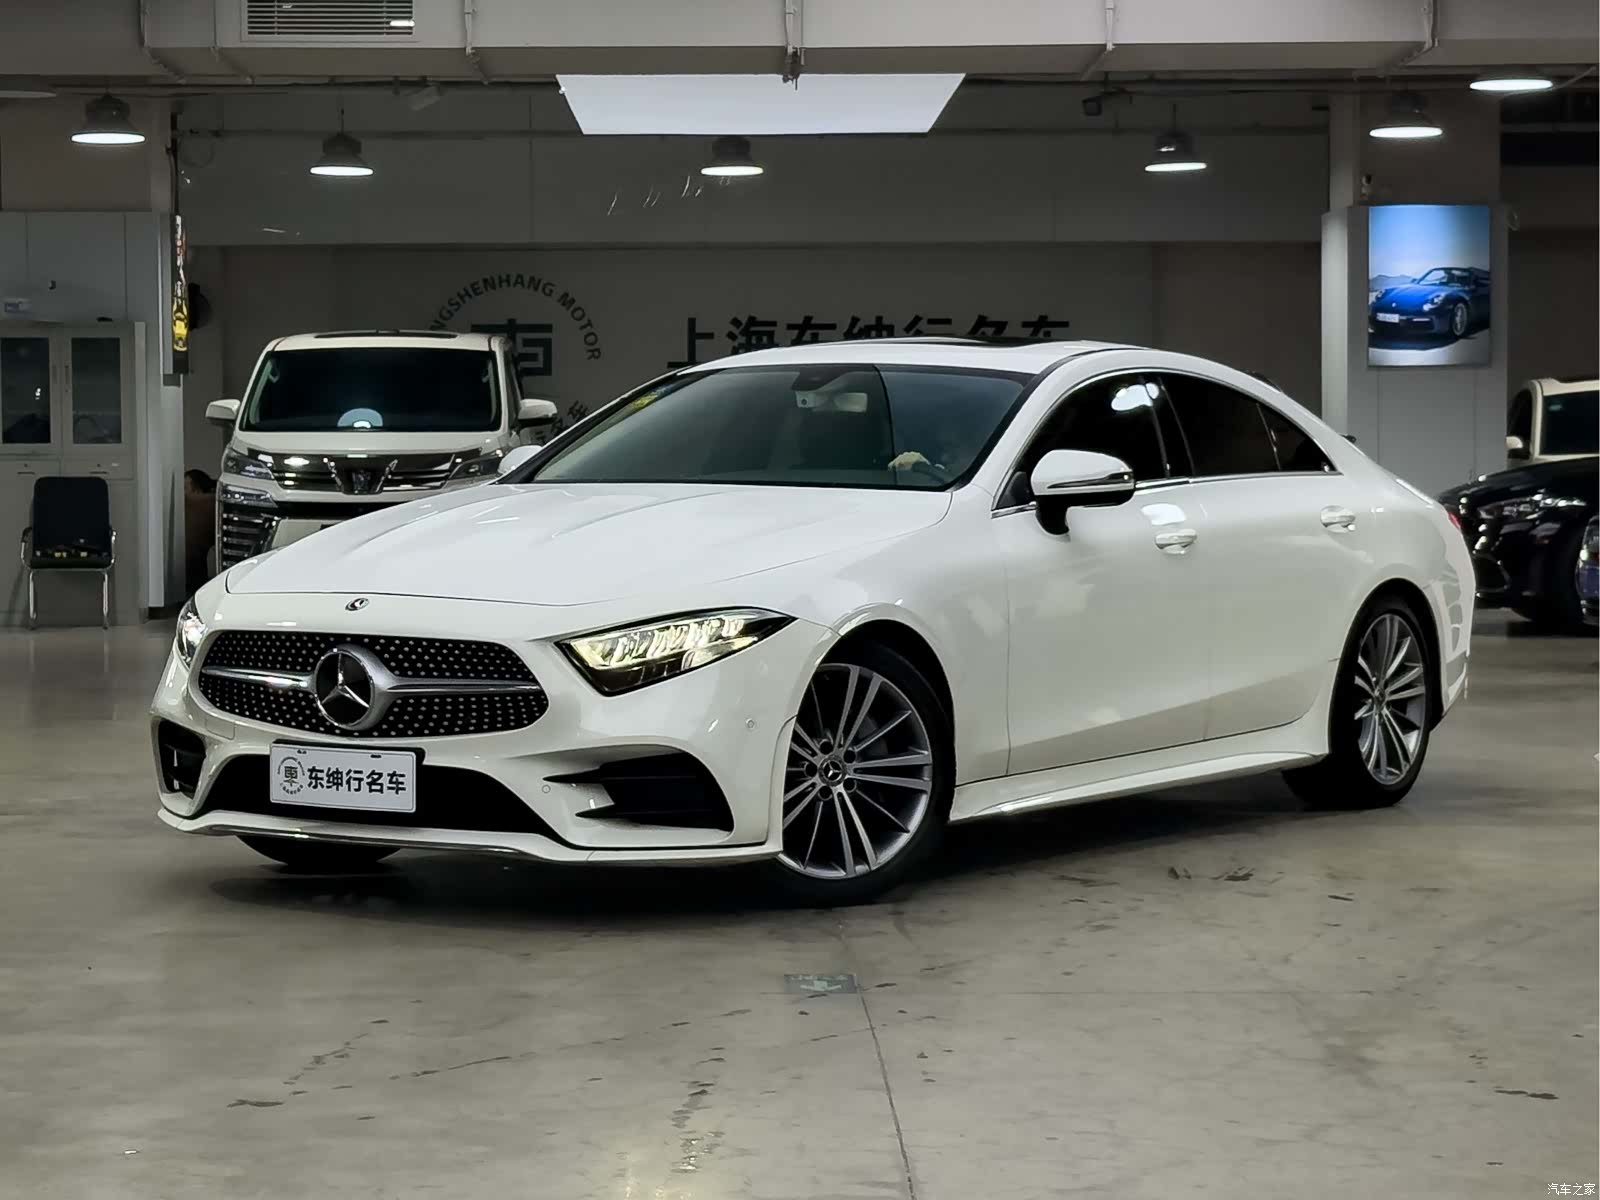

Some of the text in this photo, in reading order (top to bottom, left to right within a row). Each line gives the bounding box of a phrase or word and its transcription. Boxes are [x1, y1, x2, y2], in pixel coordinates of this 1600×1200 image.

[557, 292, 602, 361] MOTOR
[307, 766, 407, 795] 东绅行名车
